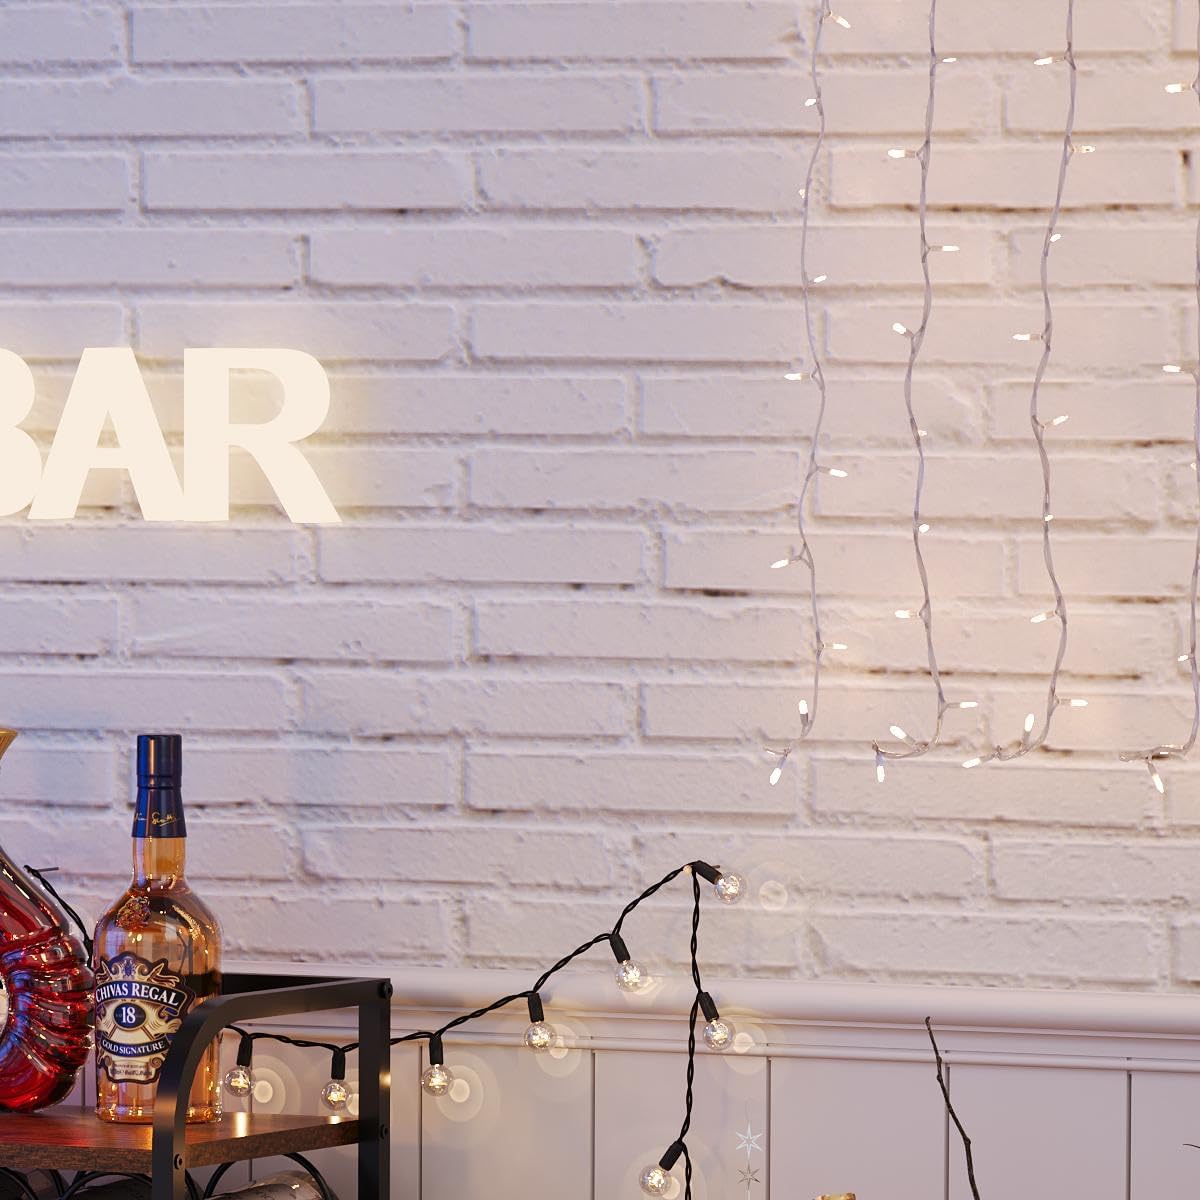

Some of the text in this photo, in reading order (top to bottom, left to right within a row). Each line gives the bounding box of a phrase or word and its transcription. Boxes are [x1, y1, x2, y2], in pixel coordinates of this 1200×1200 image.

[96, 982, 179, 1006] CHIVAS REGAL
[121, 1007, 136, 1024] 18
[119, 1041, 165, 1055] SIGNATURE
